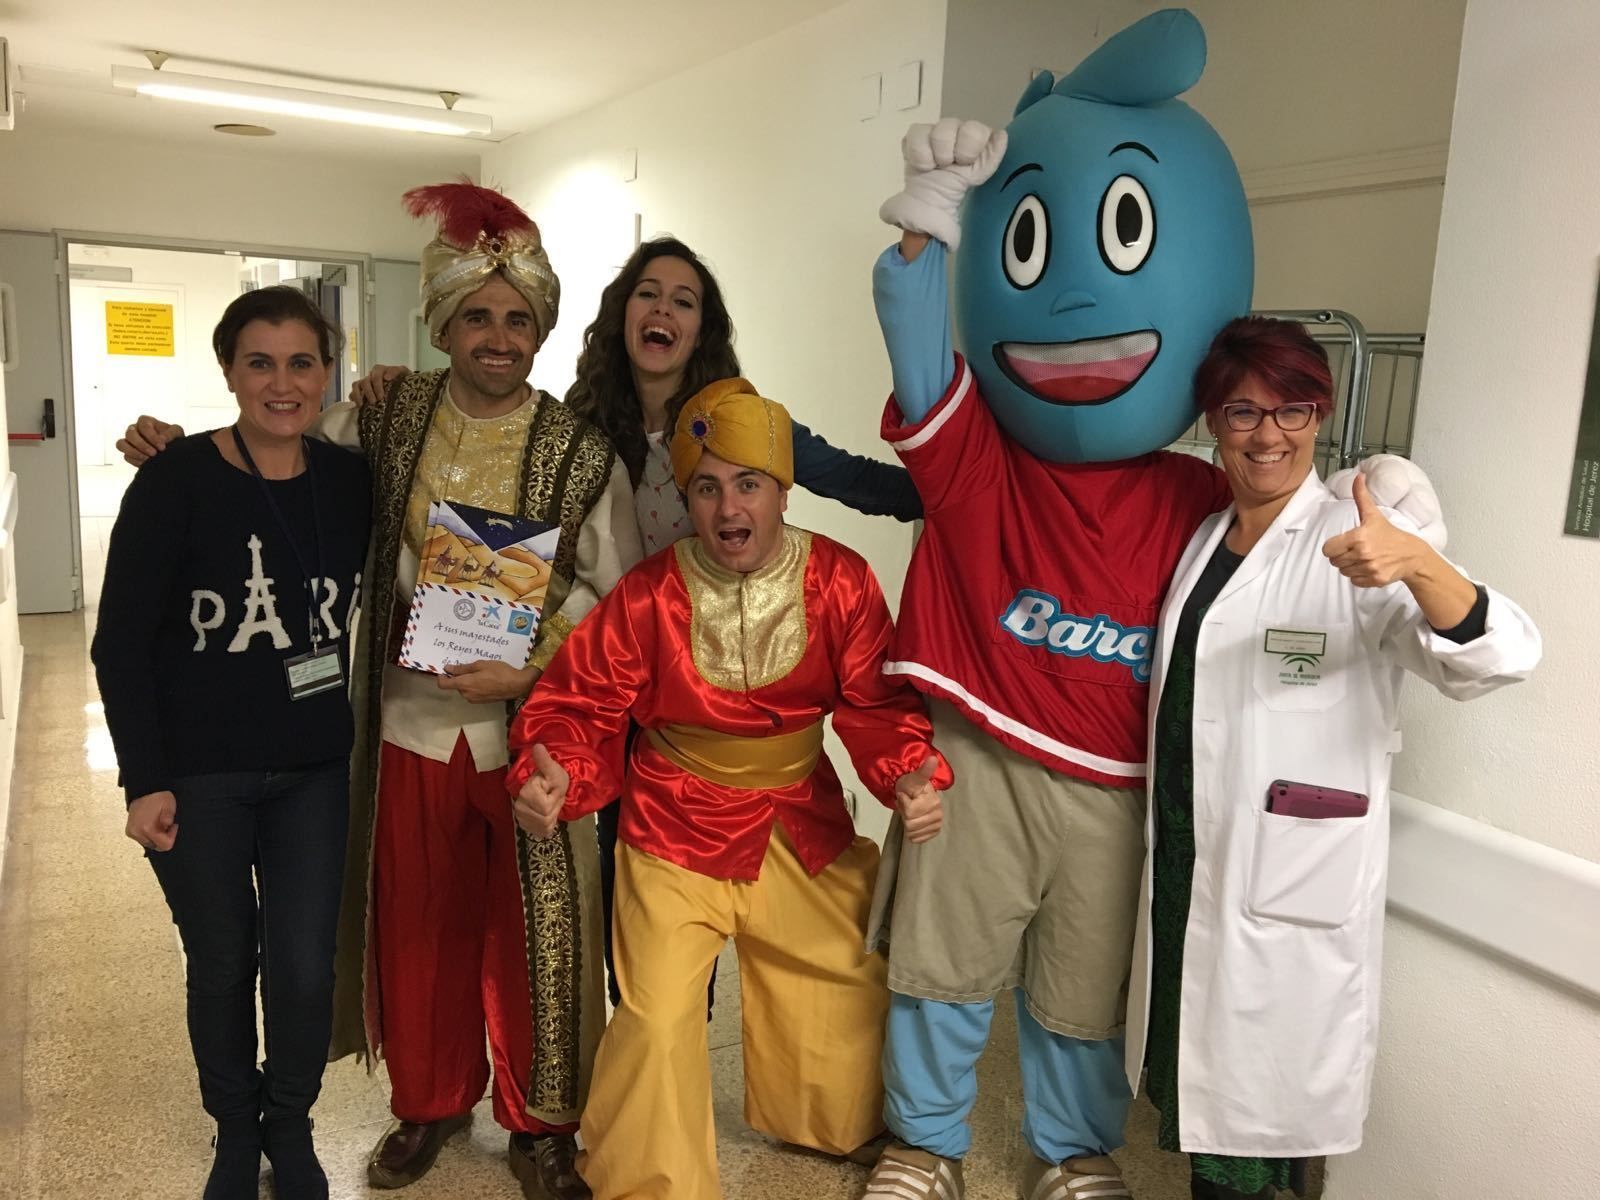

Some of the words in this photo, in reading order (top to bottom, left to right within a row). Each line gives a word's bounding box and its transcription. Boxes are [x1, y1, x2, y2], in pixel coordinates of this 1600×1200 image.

[1590, 461, 1600, 483] Jerez
[1588, 484, 1596, 496] de
[1582, 497, 1594, 532] Hospital
[433, 621, 444, 631] A
[444, 626, 458, 635] sus
[460, 629, 509, 646] majestades
[1002, 594, 1153, 677] Barc
[433, 638, 445, 648] los
[447, 640, 472, 656] Reyes
[475, 648, 502, 660] Magos
